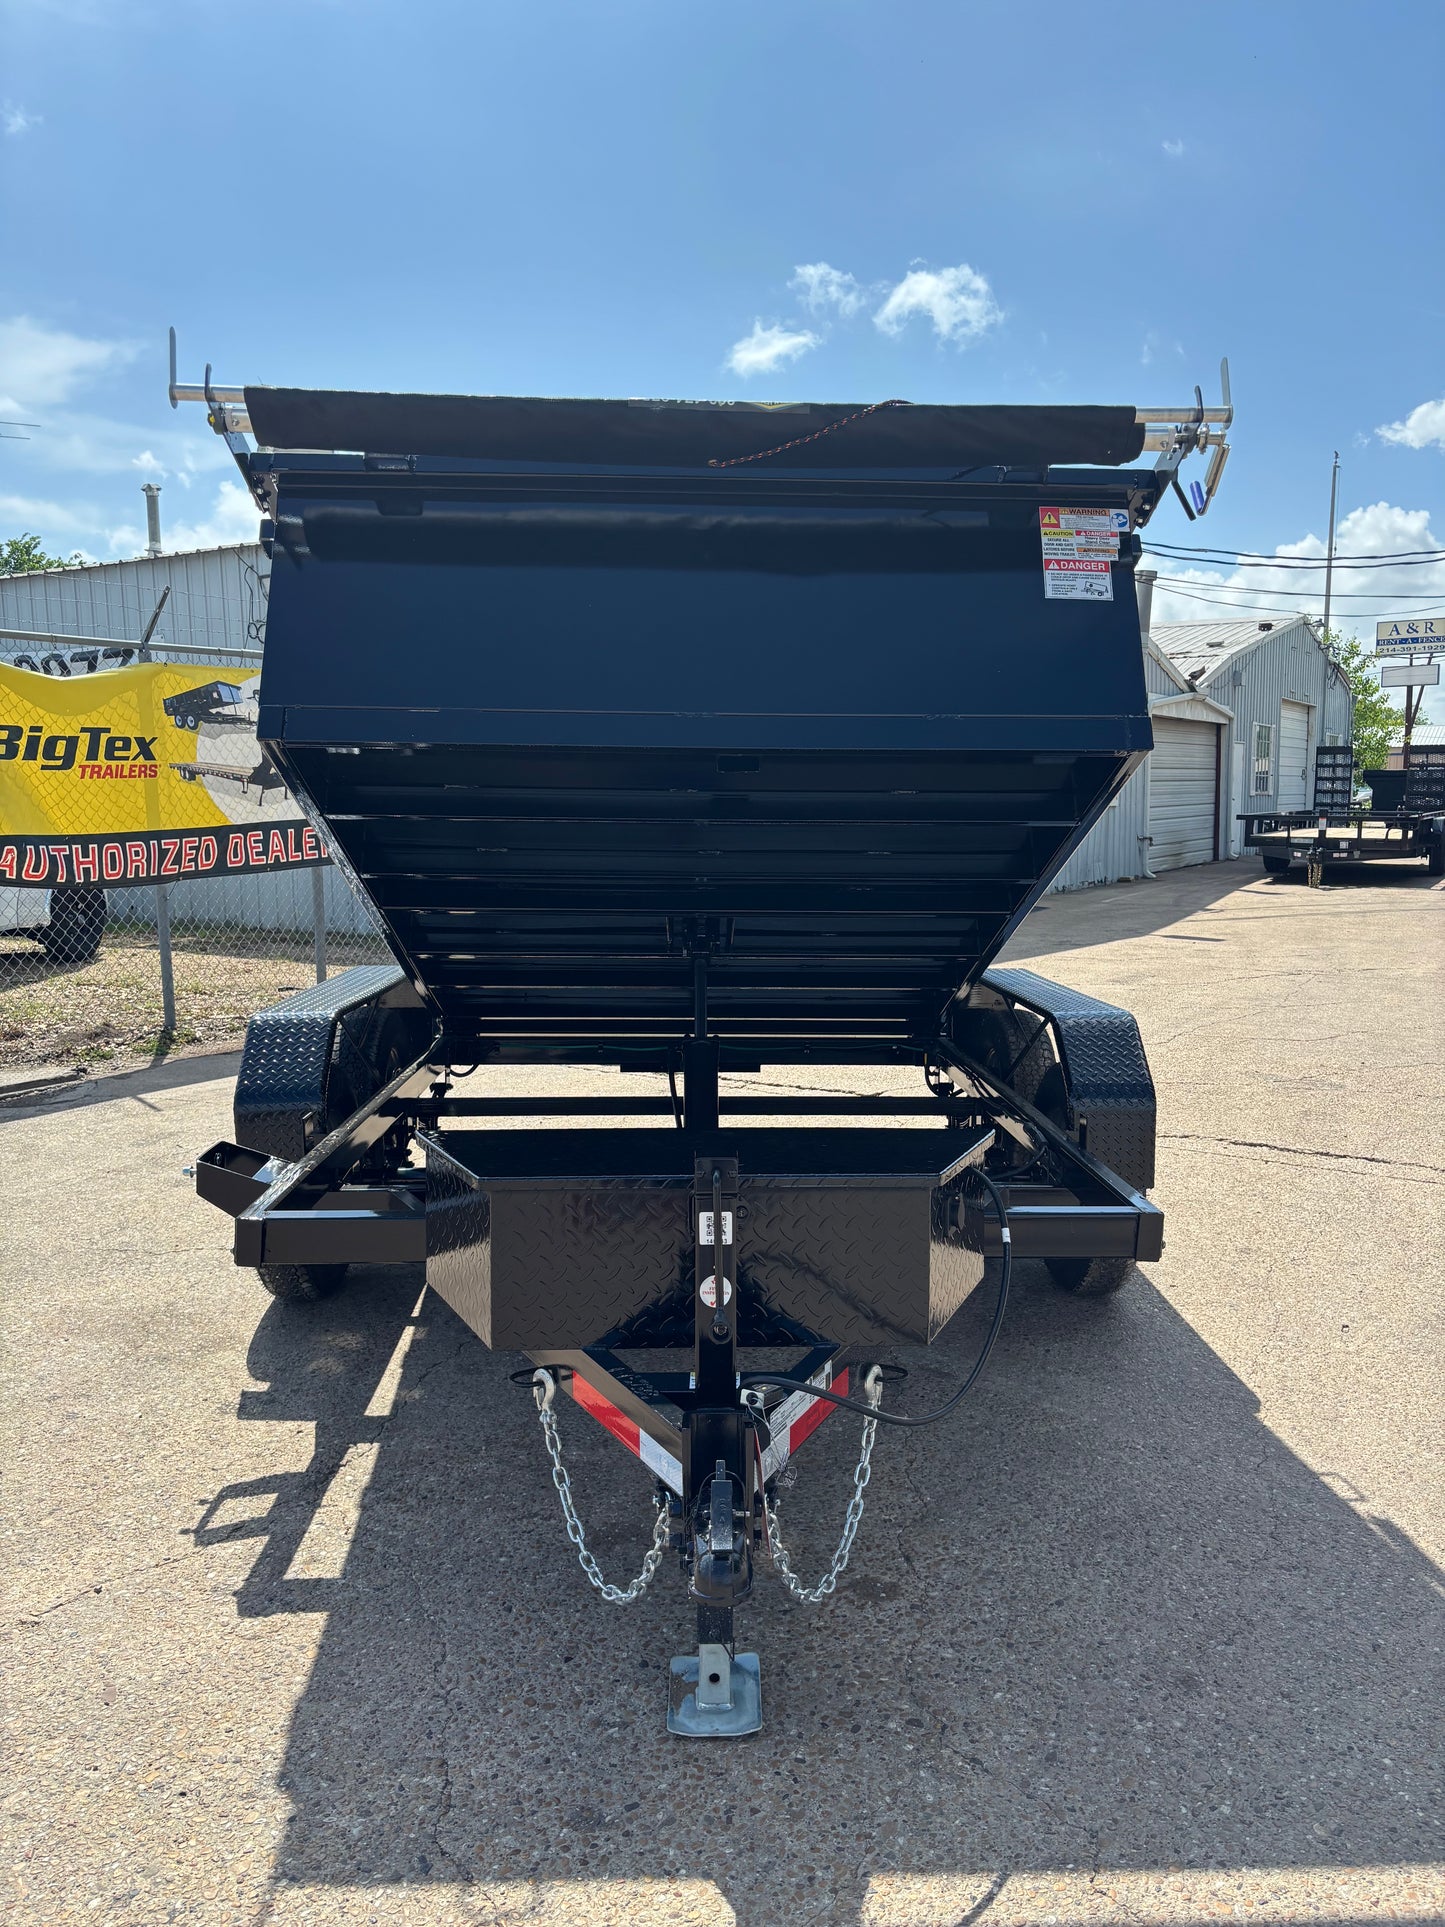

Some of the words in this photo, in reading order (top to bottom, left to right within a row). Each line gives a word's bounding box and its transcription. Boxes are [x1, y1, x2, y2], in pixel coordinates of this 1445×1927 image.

[1069, 508, 1107, 516] WARNING
[1060, 561, 1105, 571] DANGER
[1388, 623, 1402, 636] A
[1406, 622, 1419, 634] &
[1424, 621, 1436, 634] R
[1379, 644, 1445, 653] 214-391-1929
[78, 763, 159, 779] TRAILERS
[0, 831, 218, 883] AUTHORIZED
[227, 826, 328, 867] DEALE
